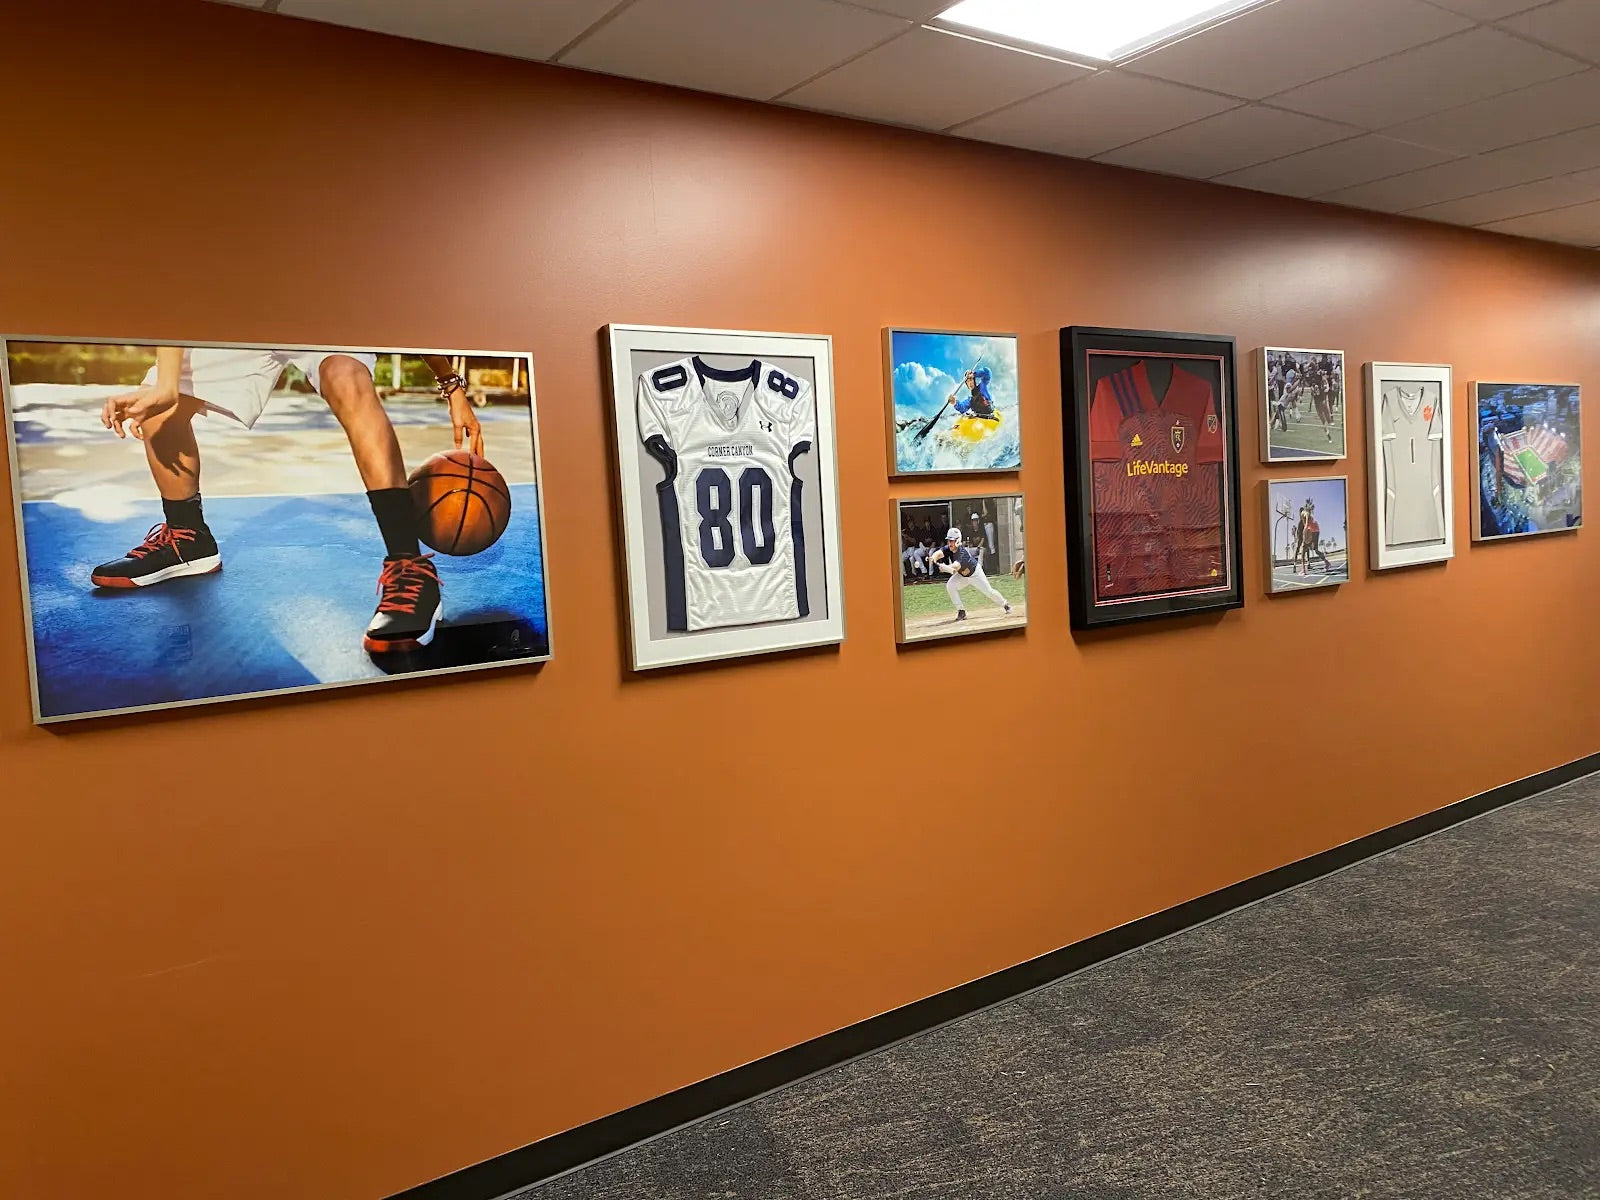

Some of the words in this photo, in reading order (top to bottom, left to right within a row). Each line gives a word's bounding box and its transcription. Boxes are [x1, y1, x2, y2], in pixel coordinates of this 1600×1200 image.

[767, 369, 800, 400] 8
[707, 446, 731, 457] CORNER
[731, 445, 753, 456] CANYON
[1127, 460, 1189, 477] LifeVantage
[695, 467, 776, 568] 80
